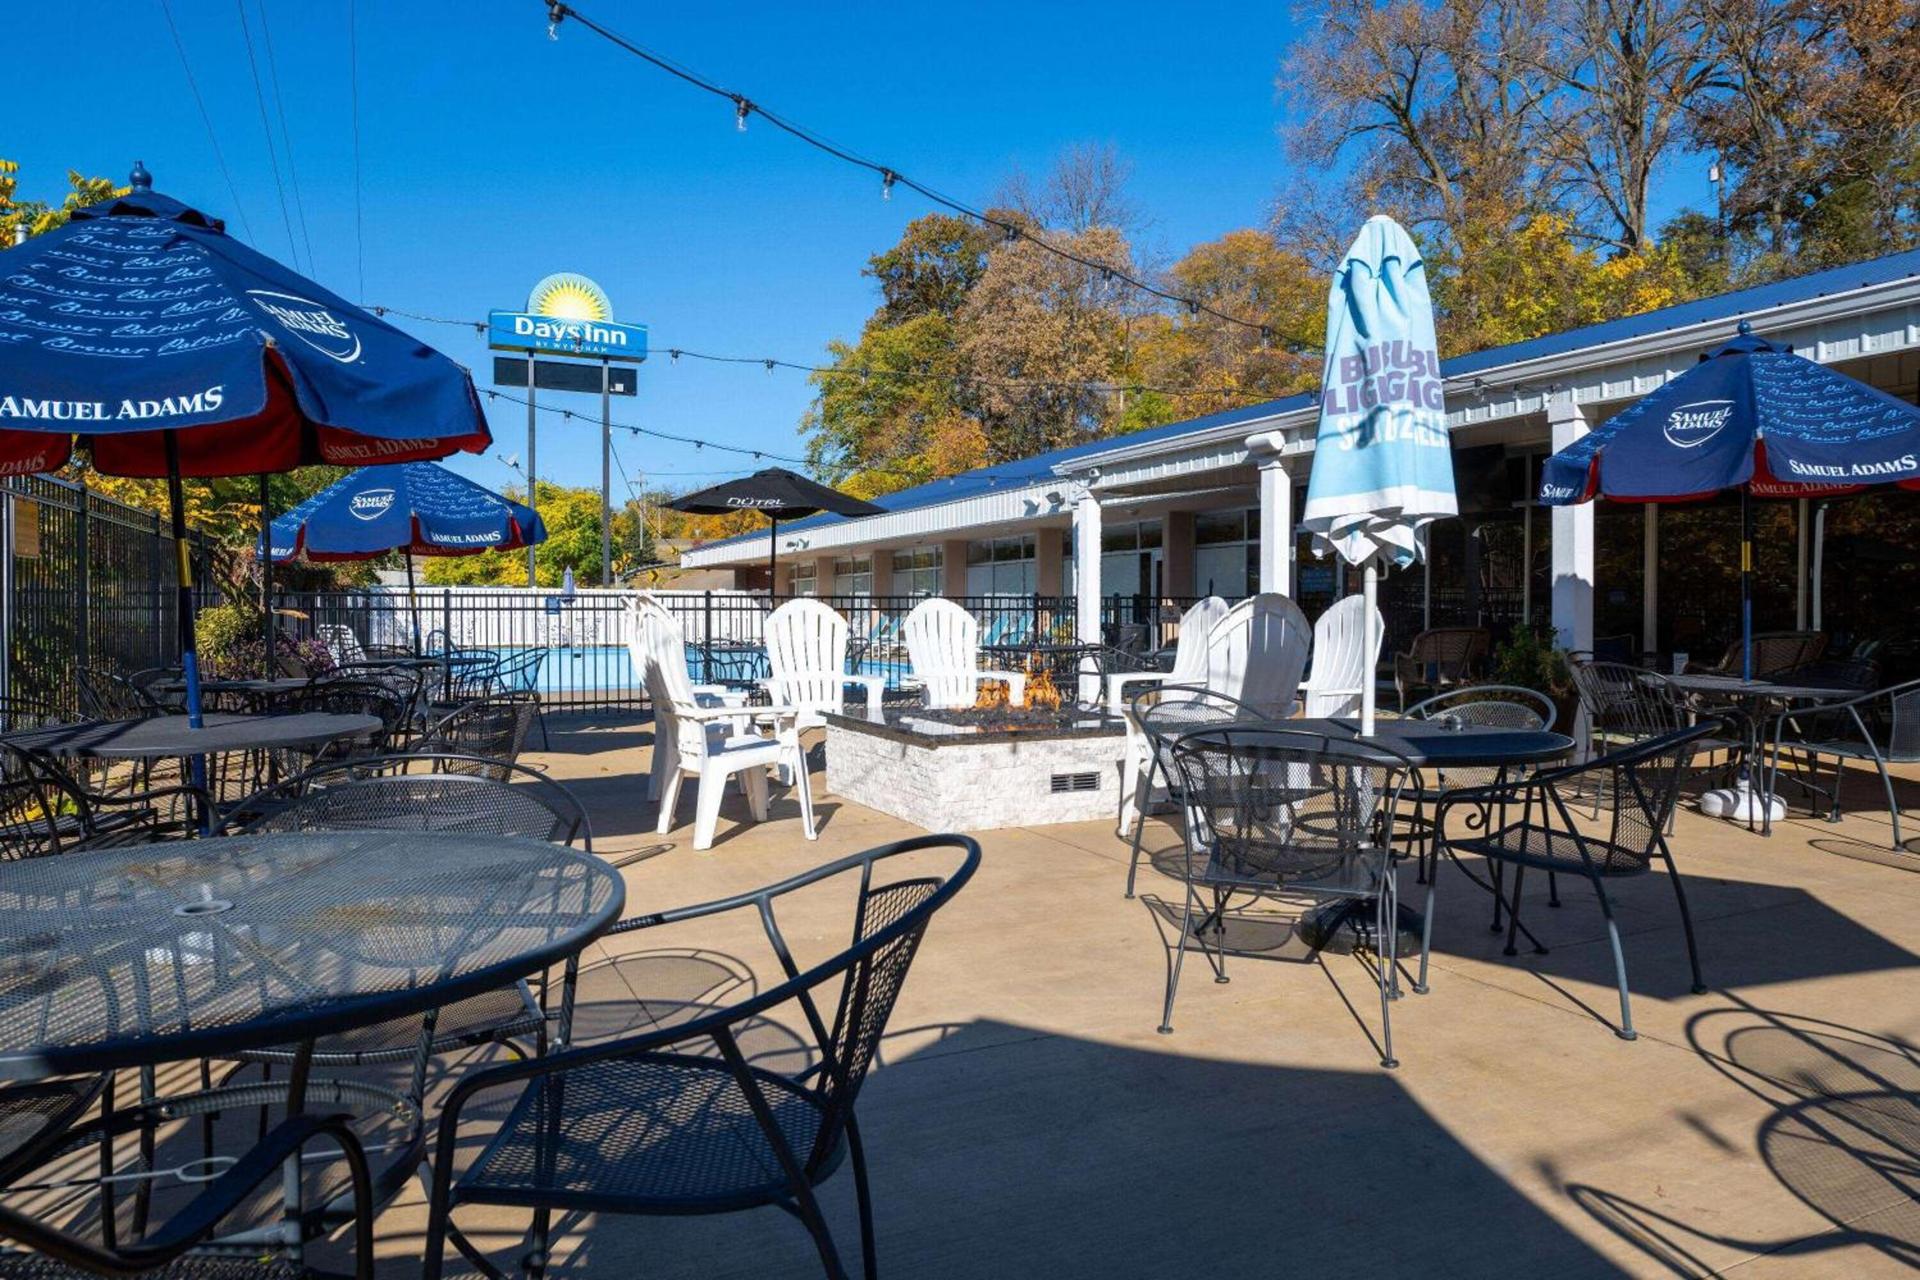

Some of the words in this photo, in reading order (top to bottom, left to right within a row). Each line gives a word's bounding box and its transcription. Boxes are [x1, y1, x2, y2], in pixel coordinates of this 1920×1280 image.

[58, 265, 158, 286] Brewer
[5, 274, 110, 301] Brewer
[49, 301, 154, 319] Brewer
[252, 297, 347, 327] SAMUEL
[514, 316, 580, 341] Days
[585, 321, 627, 345] Inn
[41, 336, 151, 357] Brewer
[0, 395, 111, 420] AMUEL
[115, 384, 225, 419] ADAMS
[1667, 418, 1724, 431] ADAMS
[1668, 406, 1733, 423] SAMUEL
[1788, 459, 1850, 477] SAMUEL
[1850, 453, 1918, 476] ADAMS
[430, 530, 465, 543] SAMUEL
[464, 529, 502, 543] ADAMS
